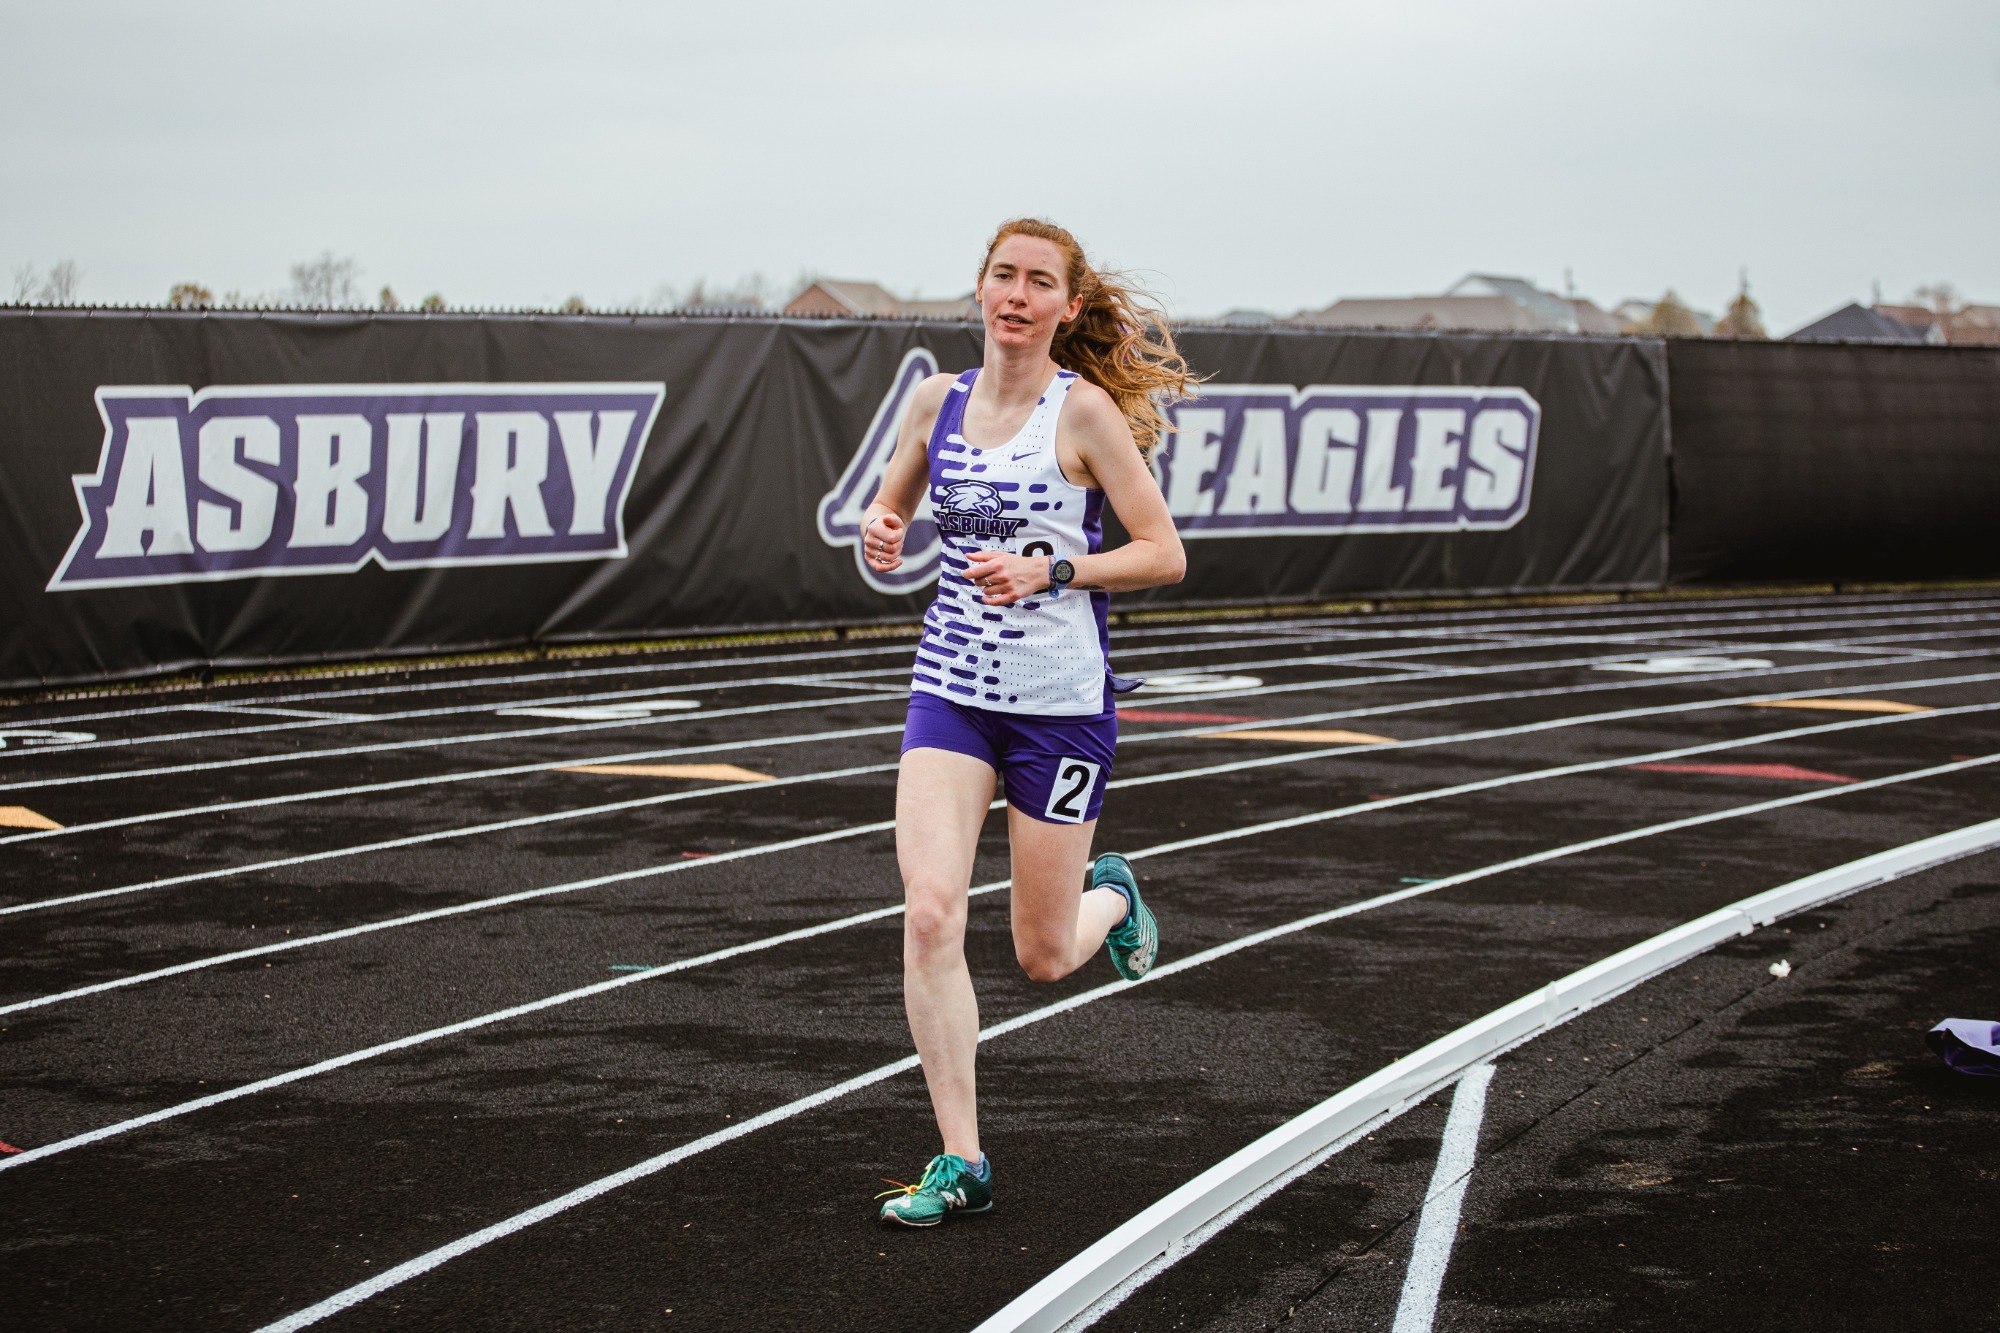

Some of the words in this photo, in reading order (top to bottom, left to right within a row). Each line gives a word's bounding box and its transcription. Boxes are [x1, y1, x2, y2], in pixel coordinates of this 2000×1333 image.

[95, 410, 638, 559] ASBURY
[1166, 407, 1528, 518] EAGLES
[939, 513, 1020, 537] ASBURY
[1051, 764, 1090, 818] 2
